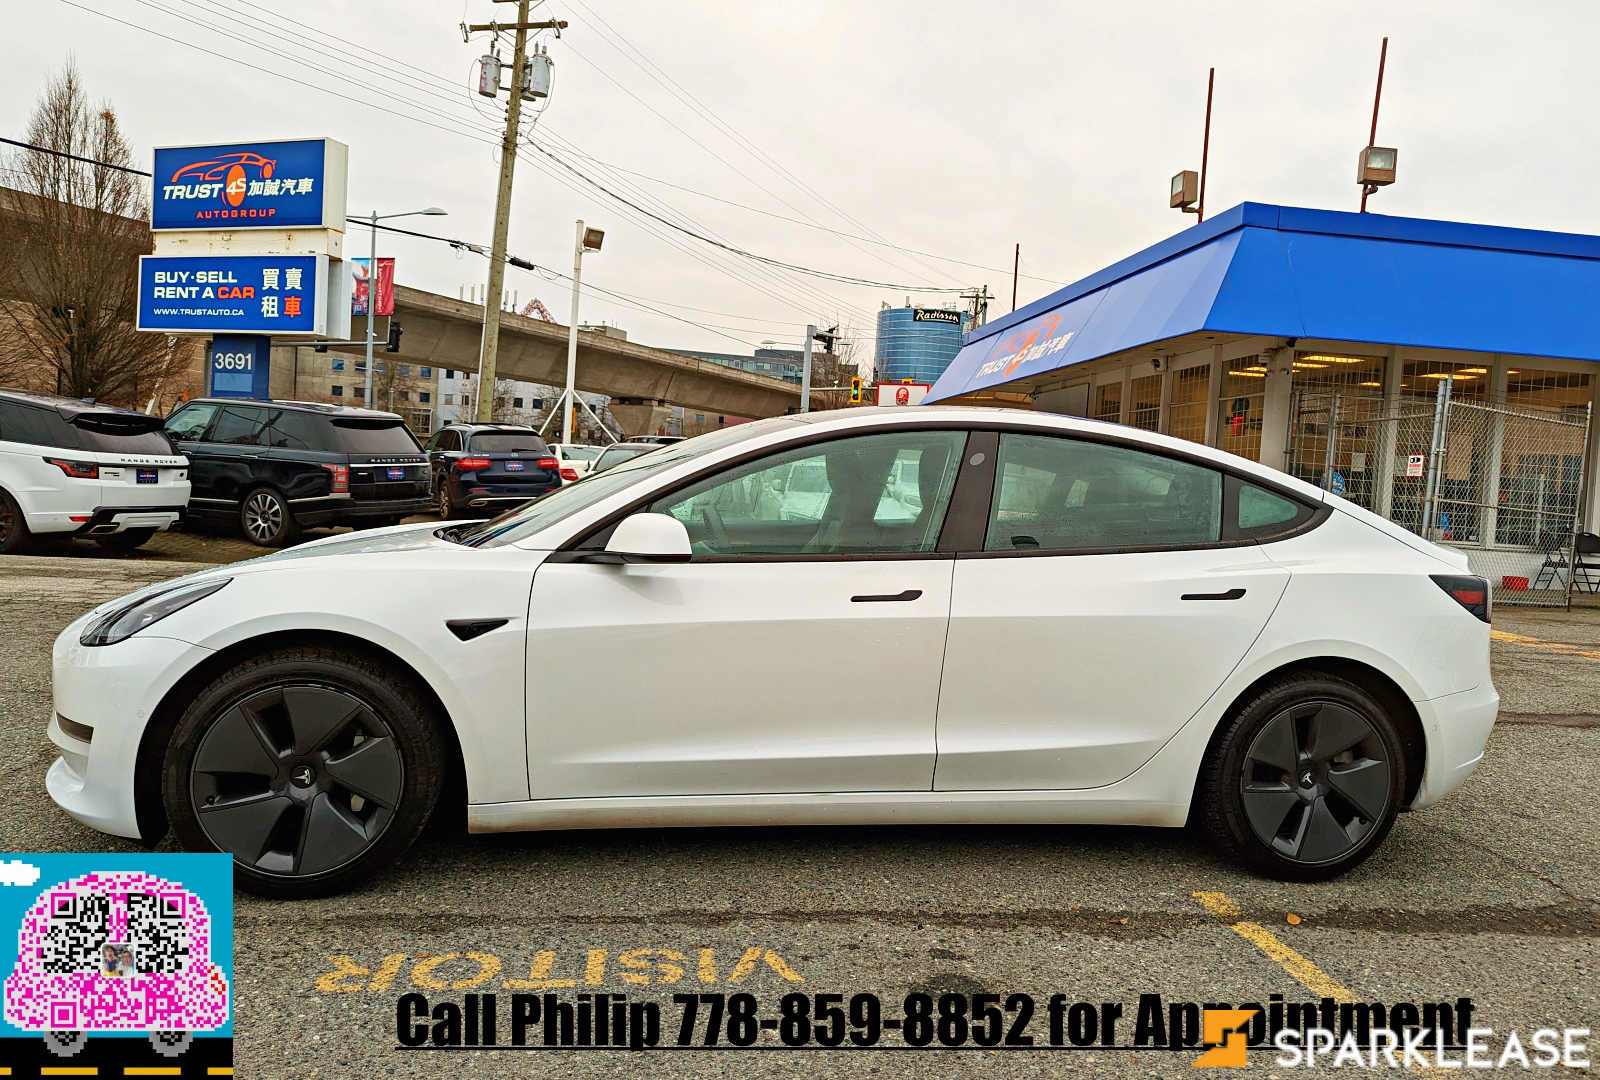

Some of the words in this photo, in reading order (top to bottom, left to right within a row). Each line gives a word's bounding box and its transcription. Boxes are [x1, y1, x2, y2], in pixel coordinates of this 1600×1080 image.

[163, 184, 223, 200] TRUST
[226, 178, 246, 196] 4S
[247, 177, 314, 196] 加誠汽車
[196, 208, 276, 219] AUTOGROUP
[153, 286, 199, 299] RENT
[202, 287, 214, 299] A
[217, 286, 255, 299] CAR
[153, 308, 245, 316] WWW.TRUSTAUTO.CA
[915, 309, 959, 323] Radisson
[215, 352, 252, 370] 3691
[315, 946, 805, 993] VISITOR
